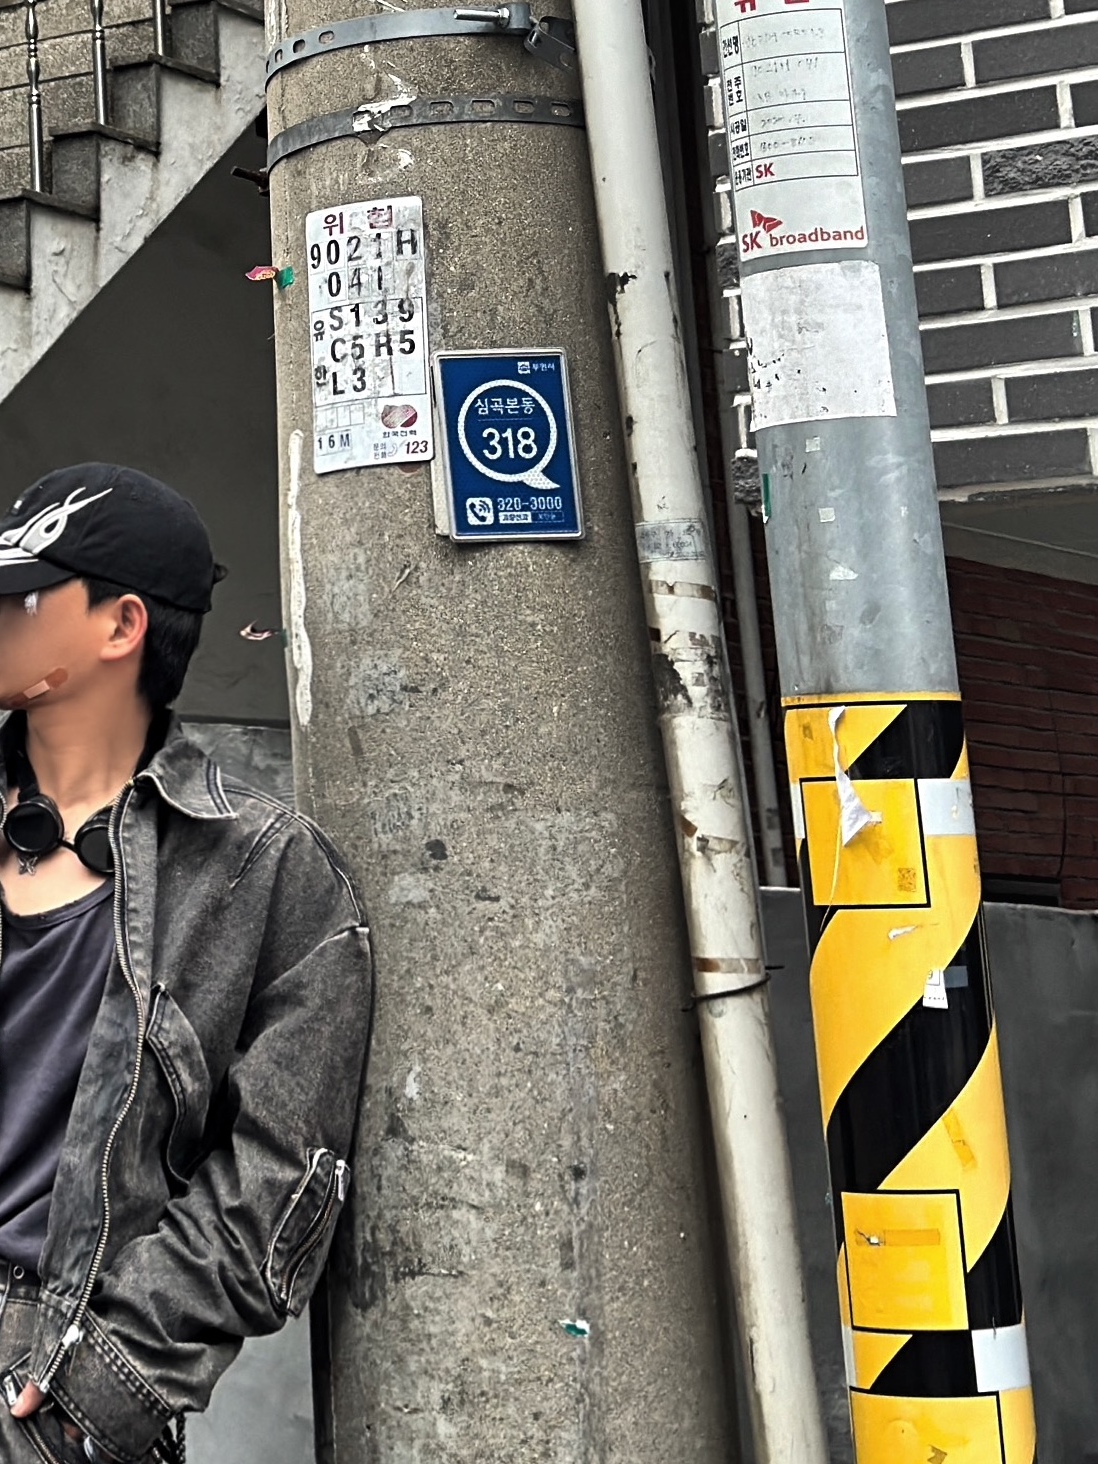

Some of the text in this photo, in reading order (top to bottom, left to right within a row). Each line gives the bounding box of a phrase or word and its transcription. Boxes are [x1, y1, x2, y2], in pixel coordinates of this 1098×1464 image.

[755, 162, 775, 179] SK
[742, 225, 865, 253] SK broadband
[474, 397, 536, 416] 심곡본동
[405, 440, 428, 454] 123
[482, 426, 538, 460] 318
[497, 496, 562, 511] 320-3000
